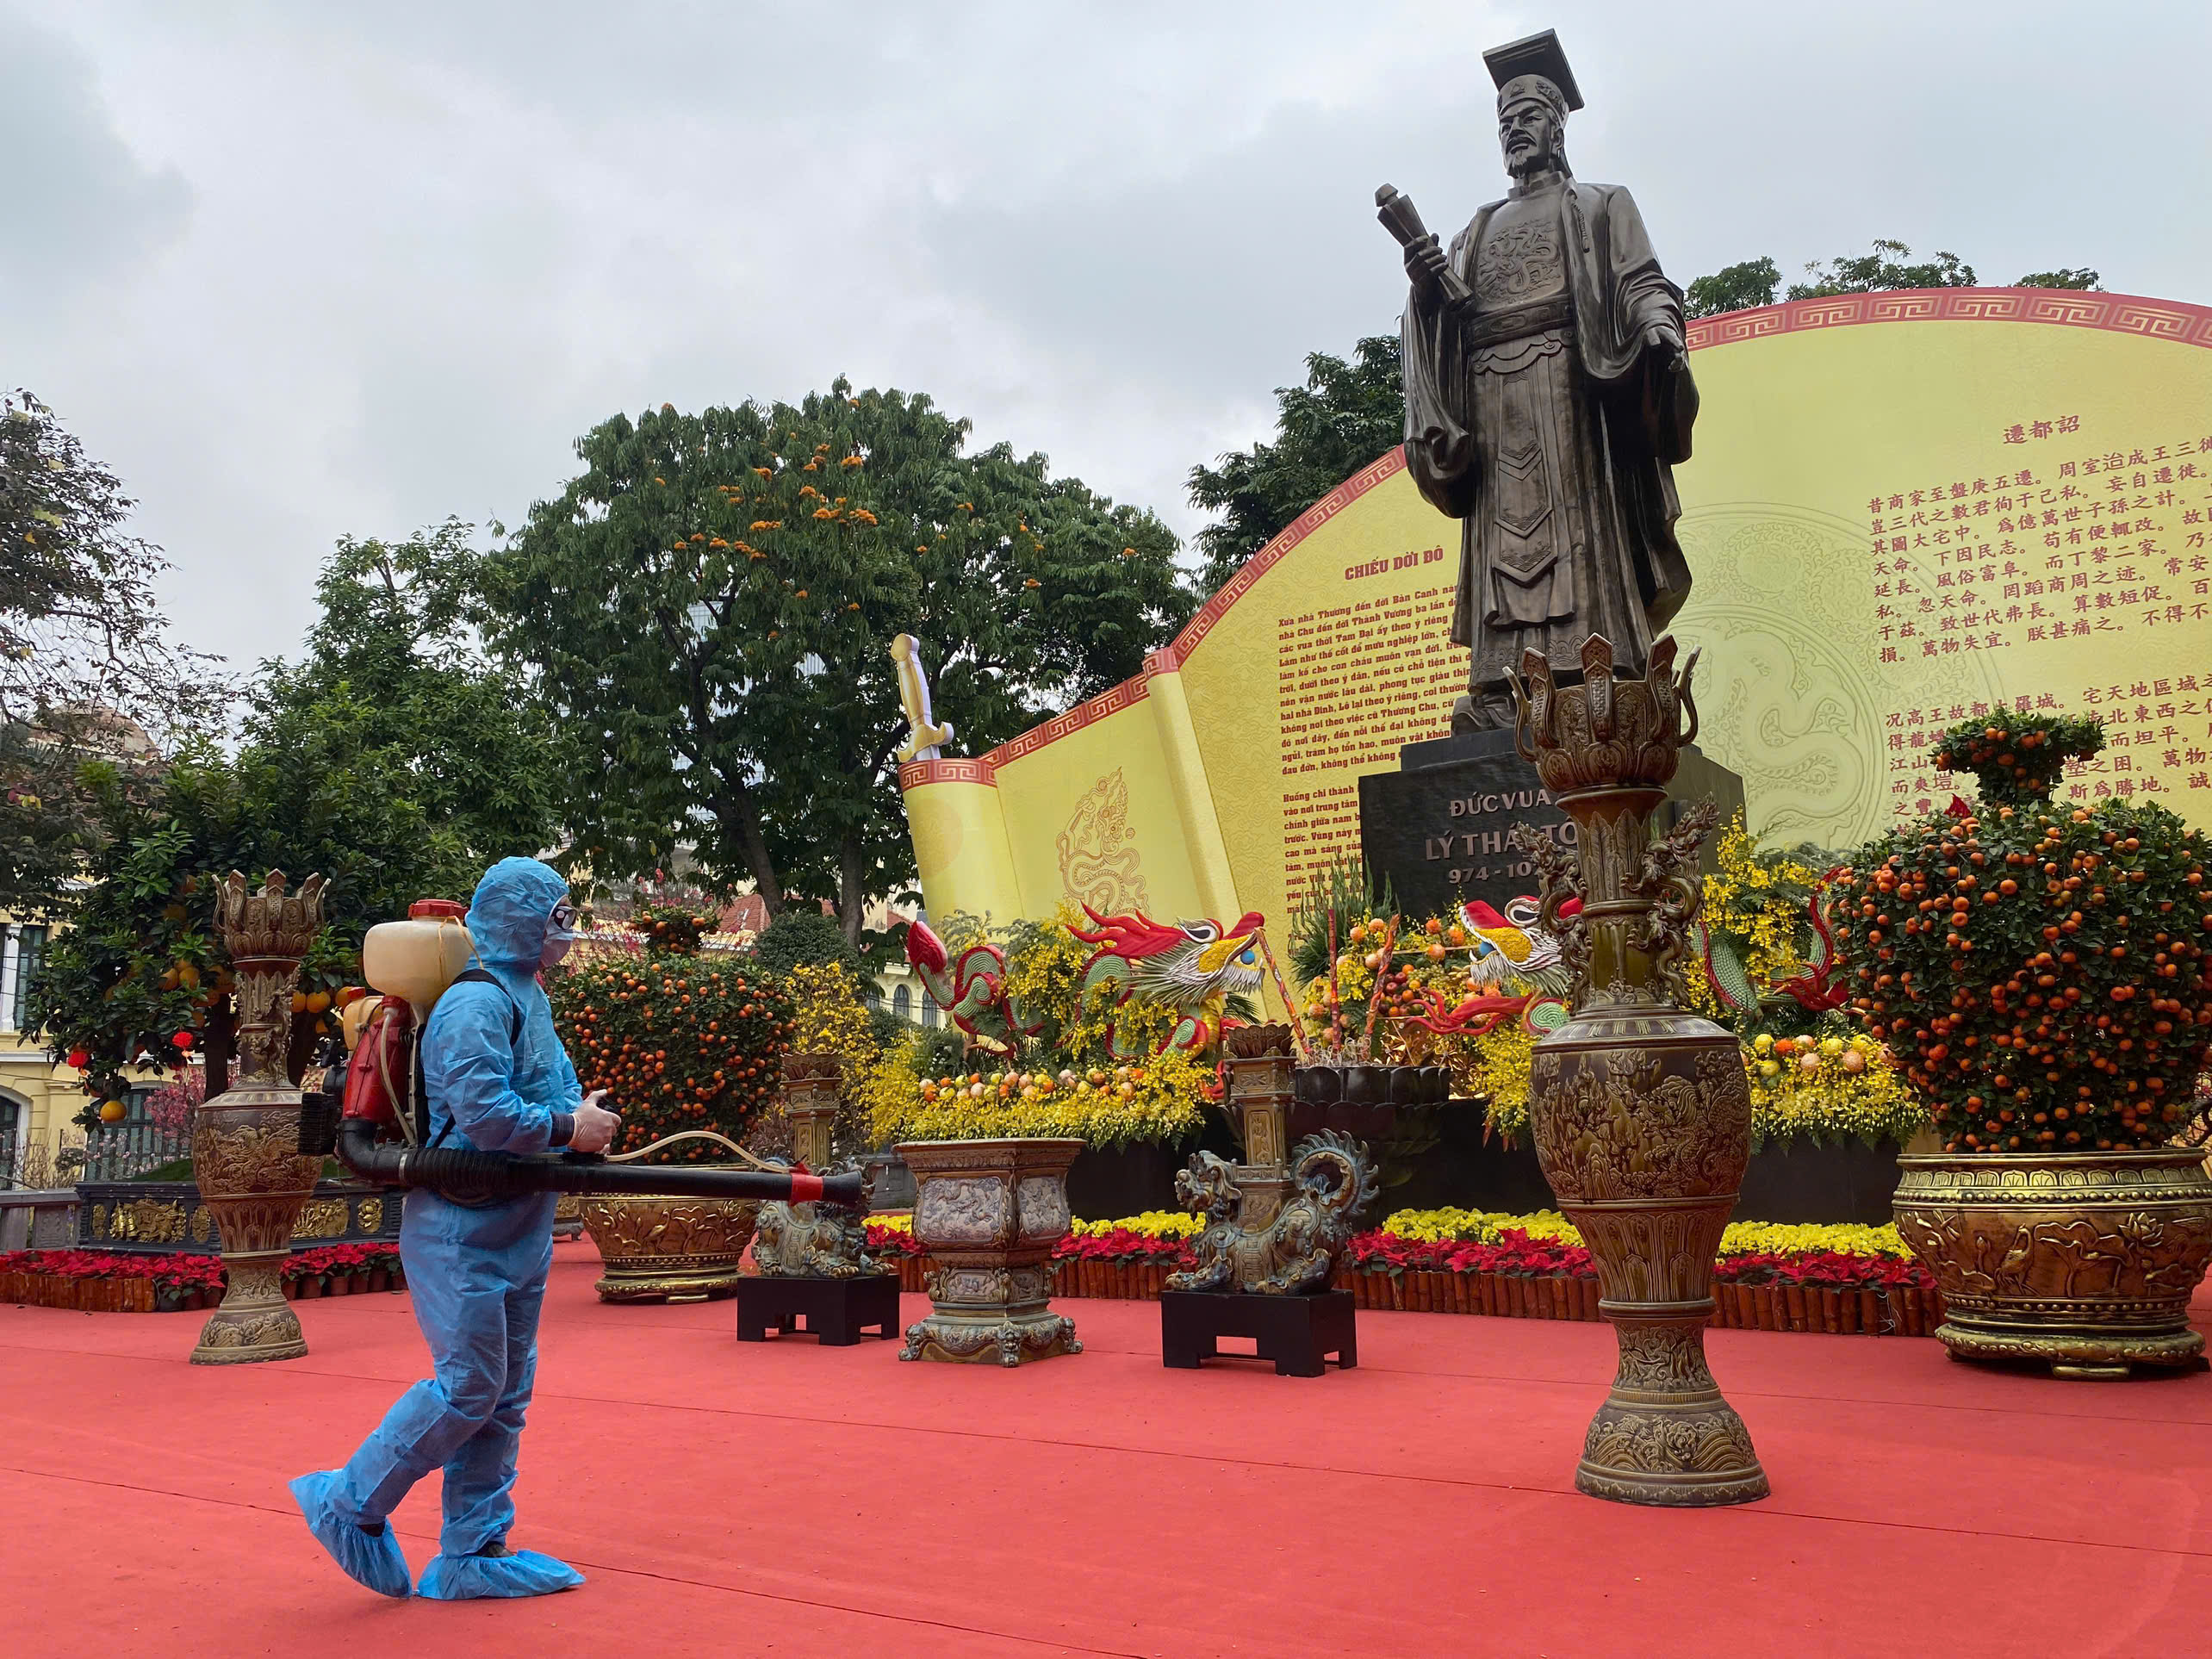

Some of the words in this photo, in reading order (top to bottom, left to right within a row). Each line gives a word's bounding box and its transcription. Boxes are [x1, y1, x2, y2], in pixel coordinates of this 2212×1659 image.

[2003, 415, 2081, 444] 遷都詔
[1873, 508, 2212, 577] 天命。下因民志。苟有便輒改。故
[1345, 555, 1388, 580] CHIẾU
[1393, 551, 1418, 570] DỜI
[1423, 545, 1443, 563] ĐÔ
[1874, 531, 2212, 598] 延長。風俗富阜。而丁黎二家。乃
[1278, 618, 1294, 627] Xưa
[1298, 613, 1314, 623] nhà
[1317, 606, 1351, 618] Thương
[1355, 601, 1371, 611] đến
[1375, 597, 1388, 607] đời
[1392, 594, 1410, 603] Bàn
[1414, 587, 1438, 599] Canh
[1278, 630, 1294, 640] nhà
[1297, 627, 1314, 636] Chu
[1316, 622, 1332, 632] đến
[1335, 619, 1348, 629] đời
[1351, 613, 1380, 625] Thành
[1383, 608, 1412, 619] Vương
[1430, 599, 1444, 610] lần
[1279, 644, 1293, 653] các
[1297, 641, 1312, 650] vua
[1315, 636, 1332, 646] thời
[1335, 633, 1355, 642] Tam
[1359, 628, 1373, 638] Đại
[1377, 624, 1387, 635] ấy
[1391, 622, 1410, 631] theo
[1415, 620, 1420, 628] ý
[1424, 615, 1447, 625] riêng
[1279, 658, 1297, 667] Làm
[1300, 652, 1317, 663] như
[1319, 648, 1332, 659] thế
[1335, 646, 1348, 656] cốt
[1351, 641, 1361, 653] để
[1364, 641, 1384, 651] mưu
[1387, 634, 1418, 647] nghiệp
[1279, 672, 1294, 680] làm
[1298, 666, 1308, 676] kế
[1312, 665, 1327, 674] cho
[1331, 662, 1346, 670] con
[1350, 656, 1372, 667] cháu
[1376, 651, 1400, 662] muôn
[1404, 648, 1421, 658] vạn
[1280, 697, 1295, 707] nên
[1299, 694, 1314, 704] vận
[1318, 690, 1339, 700] nước
[1342, 687, 1355, 696] lâu
[1379, 679, 1407, 692] phong
[1411, 676, 1425, 685] tục
[1429, 671, 1449, 683] giàu
[1453, 668, 1471, 677] thịn
[1299, 679, 1317, 690] dưới
[1320, 677, 1339, 686] theo
[1342, 674, 1347, 683] ý
[1373, 665, 1390, 677] nếu
[1393, 664, 1404, 673] có
[1407, 658, 1424, 670] chỗ
[1427, 657, 1445, 668] tiện
[1449, 654, 1462, 663] thì
[1280, 711, 1294, 720] hai
[1295, 708, 1311, 718] nhà
[1338, 701, 1349, 710] Lê
[1351, 698, 1363, 709] lại
[1364, 697, 1384, 706] theo
[1386, 694, 1392, 704] ý
[1423, 687, 1437, 696] coi
[1281, 724, 1307, 734] không
[1309, 720, 1323, 729] noi
[1325, 718, 1344, 726] theo
[1346, 713, 1364, 723] việc
[1367, 710, 1378, 719] cũ
[1380, 706, 1415, 717] Thương
[1442, 698, 1455, 708] cứ
[1281, 738, 1291, 747] đô
[1295, 736, 1308, 745] nơi
[1333, 728, 1349, 739] đến
[1353, 725, 1367, 736] nỗi
[1371, 722, 1385, 733] thế
[1389, 720, 1403, 731] đại
[1407, 717, 1436, 727] không
[1441, 713, 1453, 722] dà
[1305, 748, 1325, 757] trăm
[1328, 746, 1339, 755] họ
[1341, 741, 1355, 751] tổn
[1381, 736, 1406, 746] muôn
[1409, 732, 1423, 744] vật
[1426, 727, 1450, 739] khôn
[2110, 722, 2212, 747] 而坦平。
[1282, 766, 1297, 775] đau
[1321, 759, 1348, 769] không
[1350, 752, 1364, 764] thể
[1367, 752, 1395, 762] không
[2065, 747, 2212, 777] 墊之困。萬物
[1283, 791, 1310, 802] Huống
[1312, 788, 1326, 798] chi
[1328, 785, 1354, 796] thành
[1283, 807, 1298, 816] vào
[1300, 804, 1314, 814] nơi
[1315, 802, 1339, 811] trung
[1341, 799, 1357, 808] tâm
[1449, 791, 1499, 817] ĐỨC
[1501, 789, 1552, 811] VUA
[1284, 819, 1308, 829] chính
[1310, 817, 1329, 828] giữa
[1332, 815, 1351, 823] nam
[1310, 831, 1333, 840] Vùng
[1335, 828, 1352, 838] này
[1303, 845, 1316, 855] mà
[1426, 830, 1454, 861] LÝ
[1461, 823, 1519, 856] THÁ
[1306, 859, 1331, 869] muôn
[1449, 867, 1489, 884] 974
[1506, 862, 1538, 878] 10
[1286, 875, 1306, 885] nước
